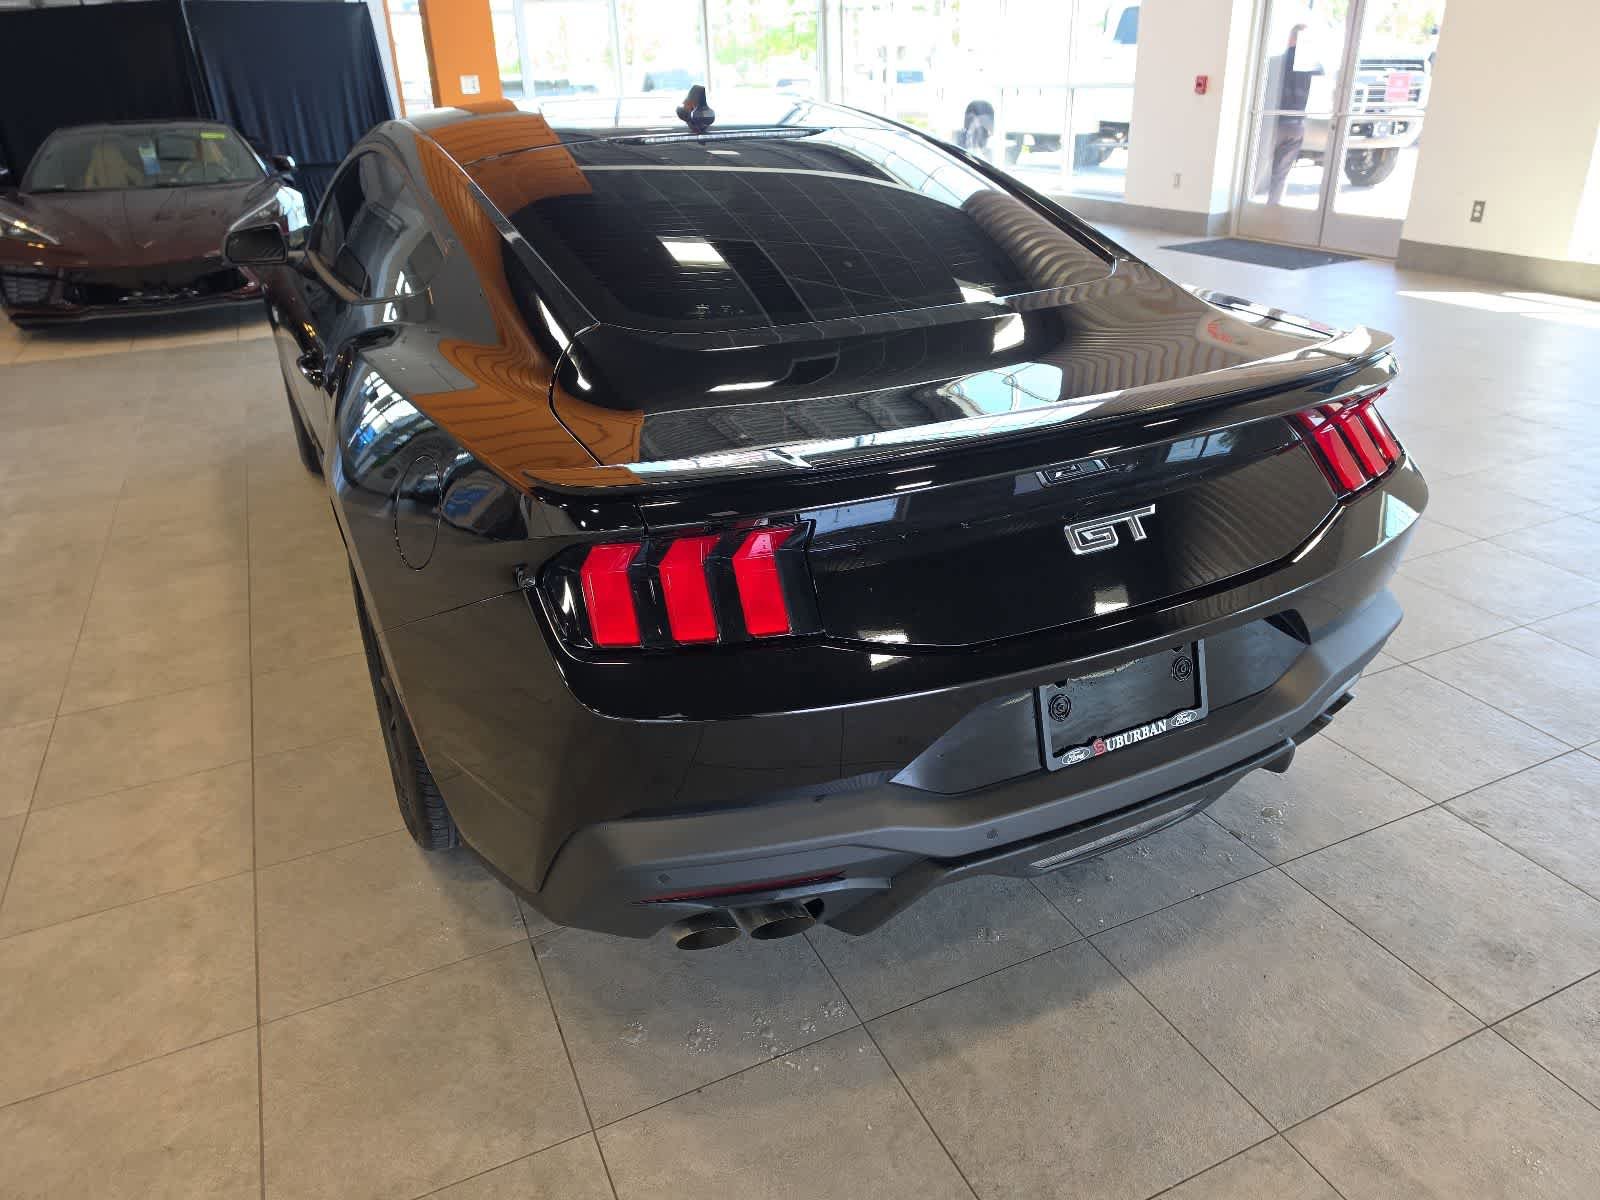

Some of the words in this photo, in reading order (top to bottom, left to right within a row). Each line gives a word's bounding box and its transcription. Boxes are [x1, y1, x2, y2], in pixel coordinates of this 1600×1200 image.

[1064, 504, 1156, 555] GT
[1065, 748, 1087, 764] Ford
[1092, 719, 1167, 756] SUBURBAN
[1174, 711, 1195, 725] Ford
